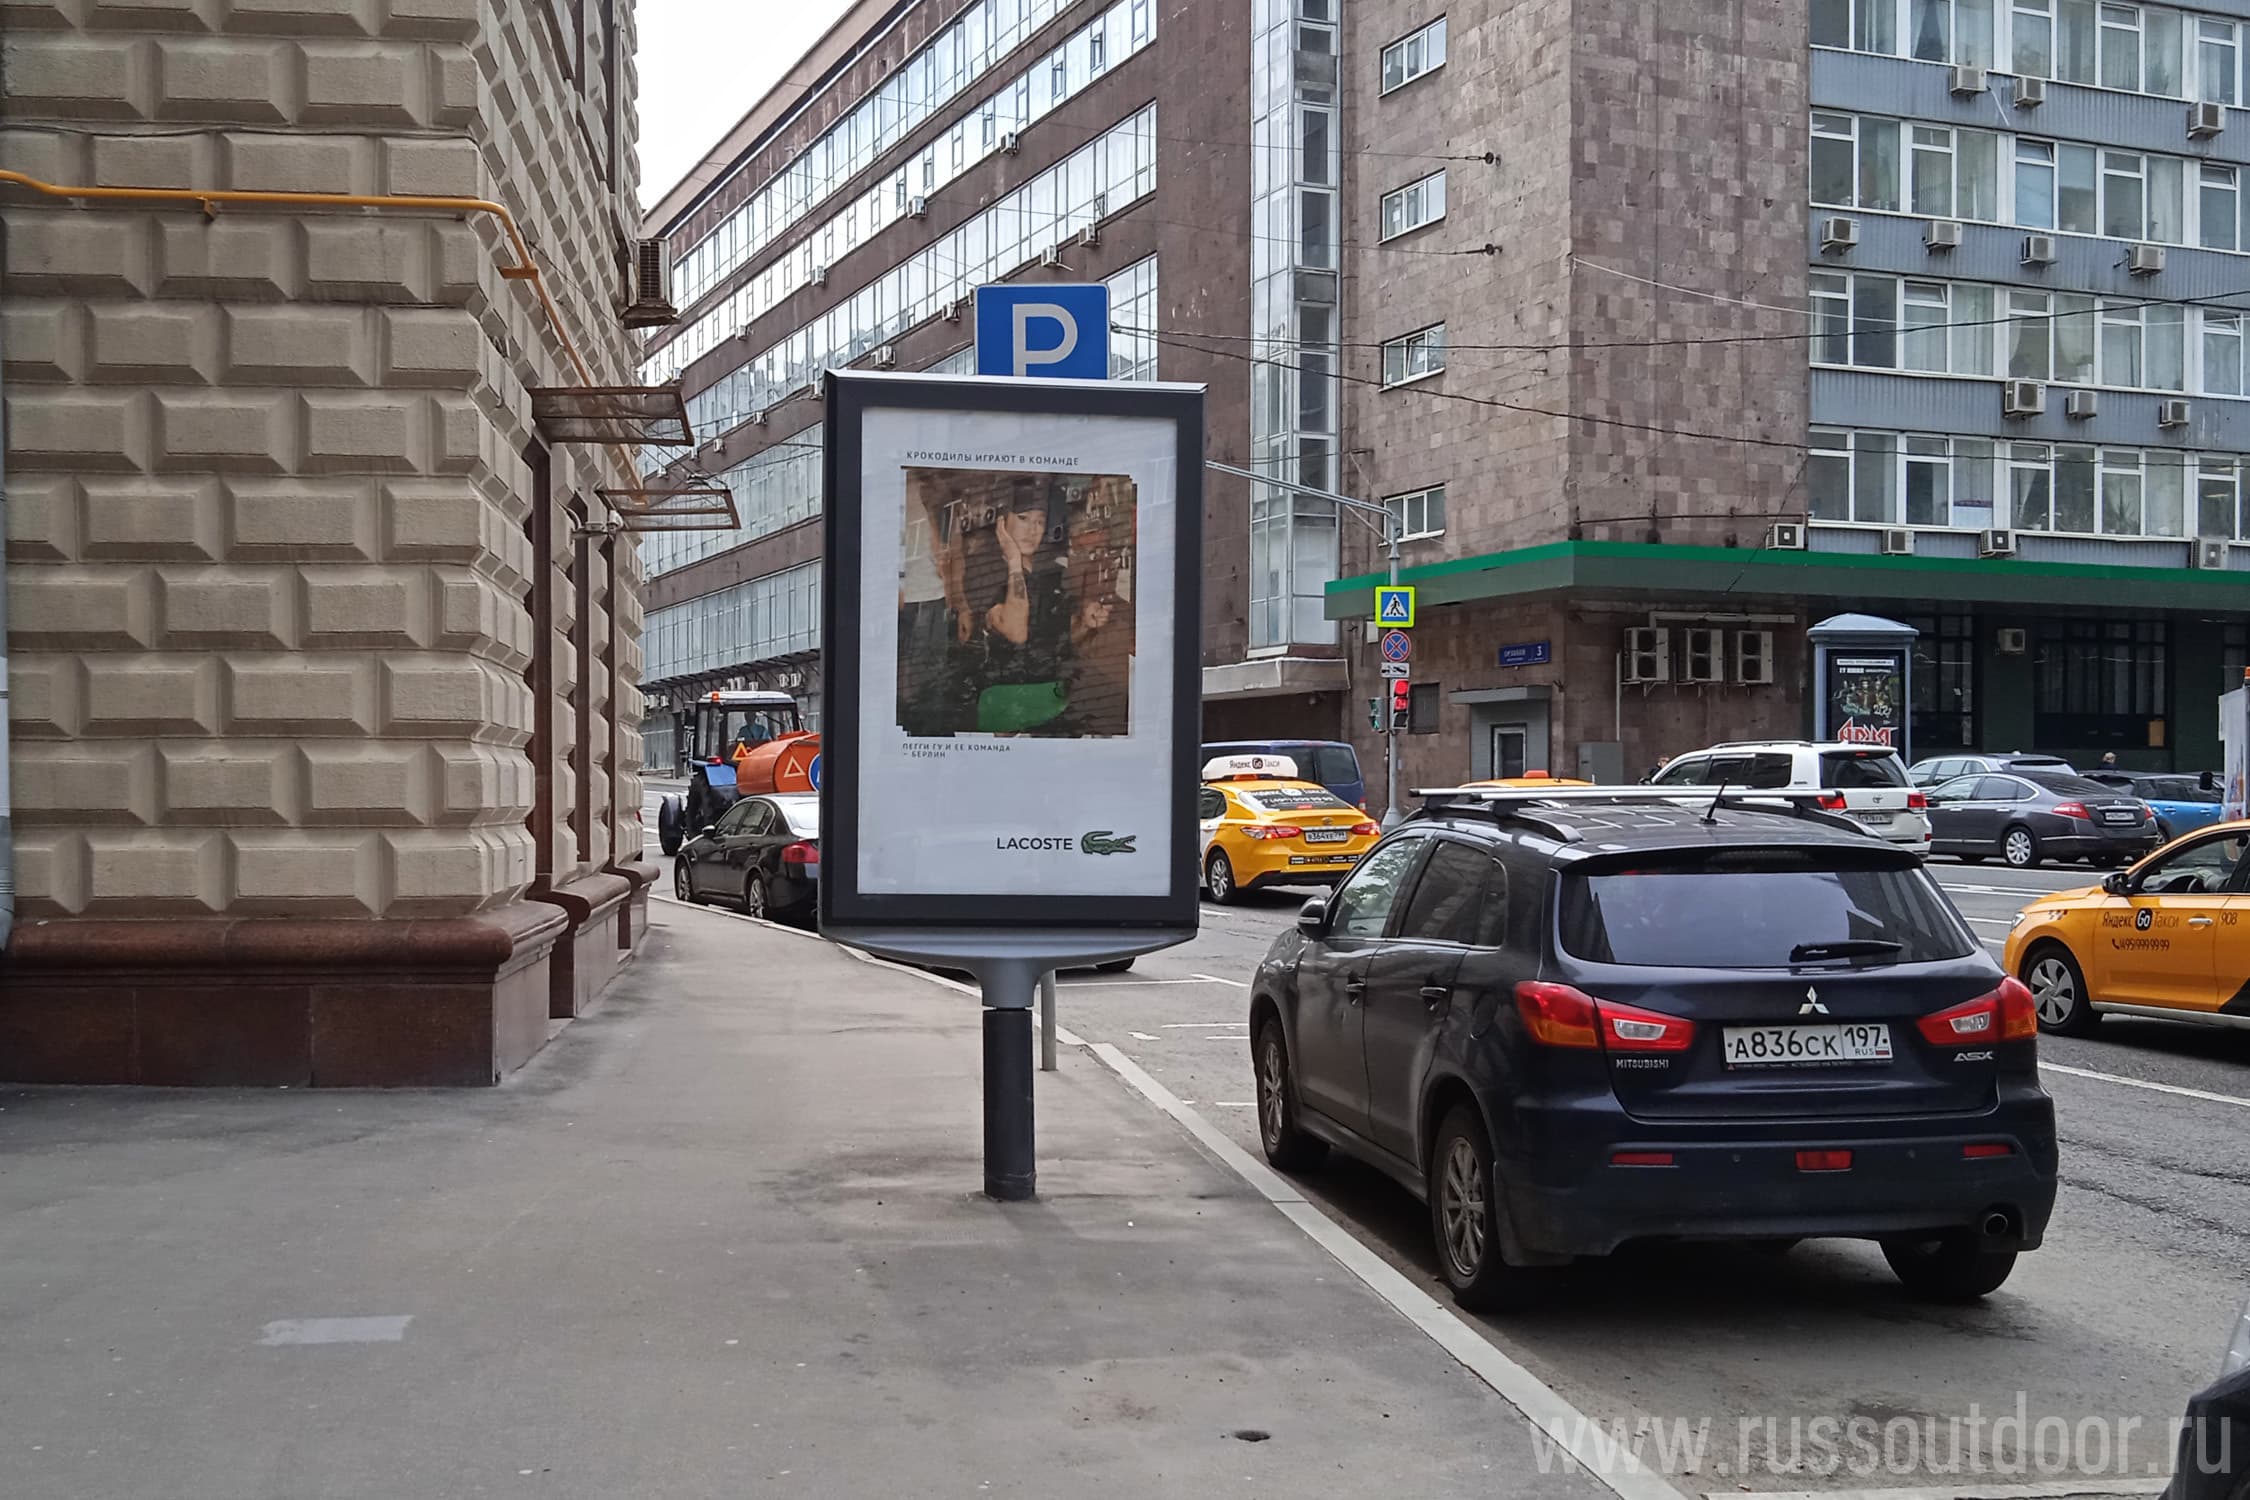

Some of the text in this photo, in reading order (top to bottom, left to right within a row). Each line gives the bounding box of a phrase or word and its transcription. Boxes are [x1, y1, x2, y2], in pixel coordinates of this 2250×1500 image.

[1012, 303, 1078, 377] P
[906, 451, 1080, 466] КРОКОДИЛЫ ИГРАЮТ В КОМАНДЕ
[902, 743, 930, 751] ПЕГГИ
[933, 743, 943, 751] ГУ
[945, 743, 951, 751] И
[968, 744, 1011, 752] КОМАНДА
[996, 837, 1073, 850] LACOSTE
[2102, 910, 2180, 928] Яндекс Go Такси
[1844, 1026, 1881, 1047] 197
[1854, 1048, 1875, 1056] RUS
[1953, 1050, 1993, 1062] ASX
[1616, 1059, 1669, 1069] MITSUBISHI
